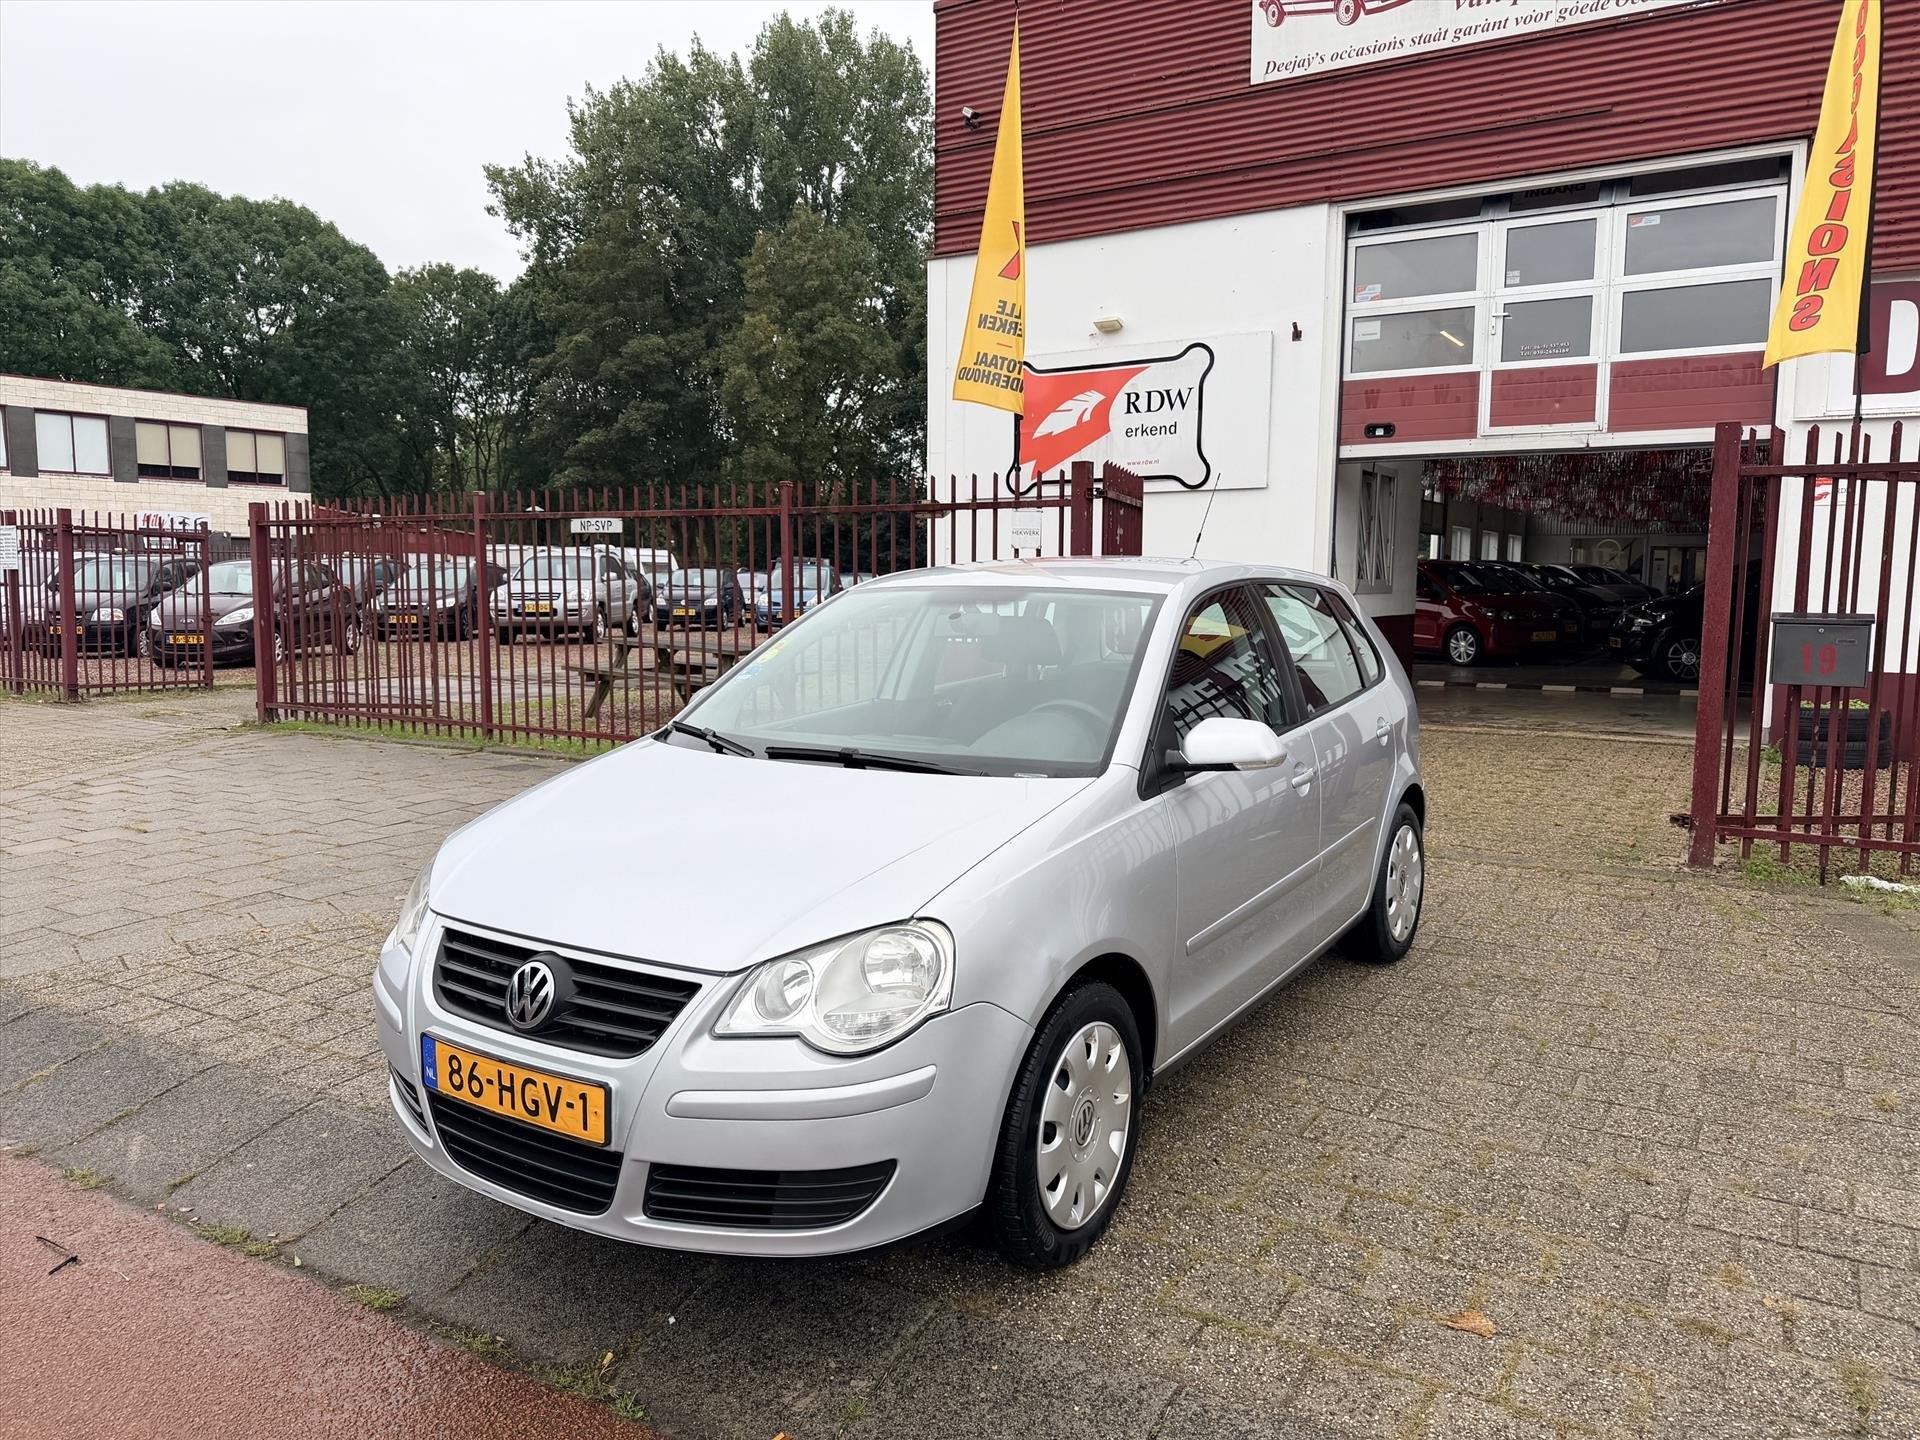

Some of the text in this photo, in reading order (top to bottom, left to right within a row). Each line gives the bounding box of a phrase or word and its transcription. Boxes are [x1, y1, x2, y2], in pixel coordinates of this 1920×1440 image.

[1264, 0, 1609, 75] Deejay's occasions staat garant voor goede
[1124, 387, 1194, 414] RDW
[1125, 421, 1177, 438] erkend
[1127, 458, 1160, 466] www.rdw.nl
[580, 520, 612, 531] NP-SVP
[1802, 644, 1836, 674] 19
[425, 1066, 437, 1080] NL
[447, 1054, 589, 1131] 86-HGV-1
